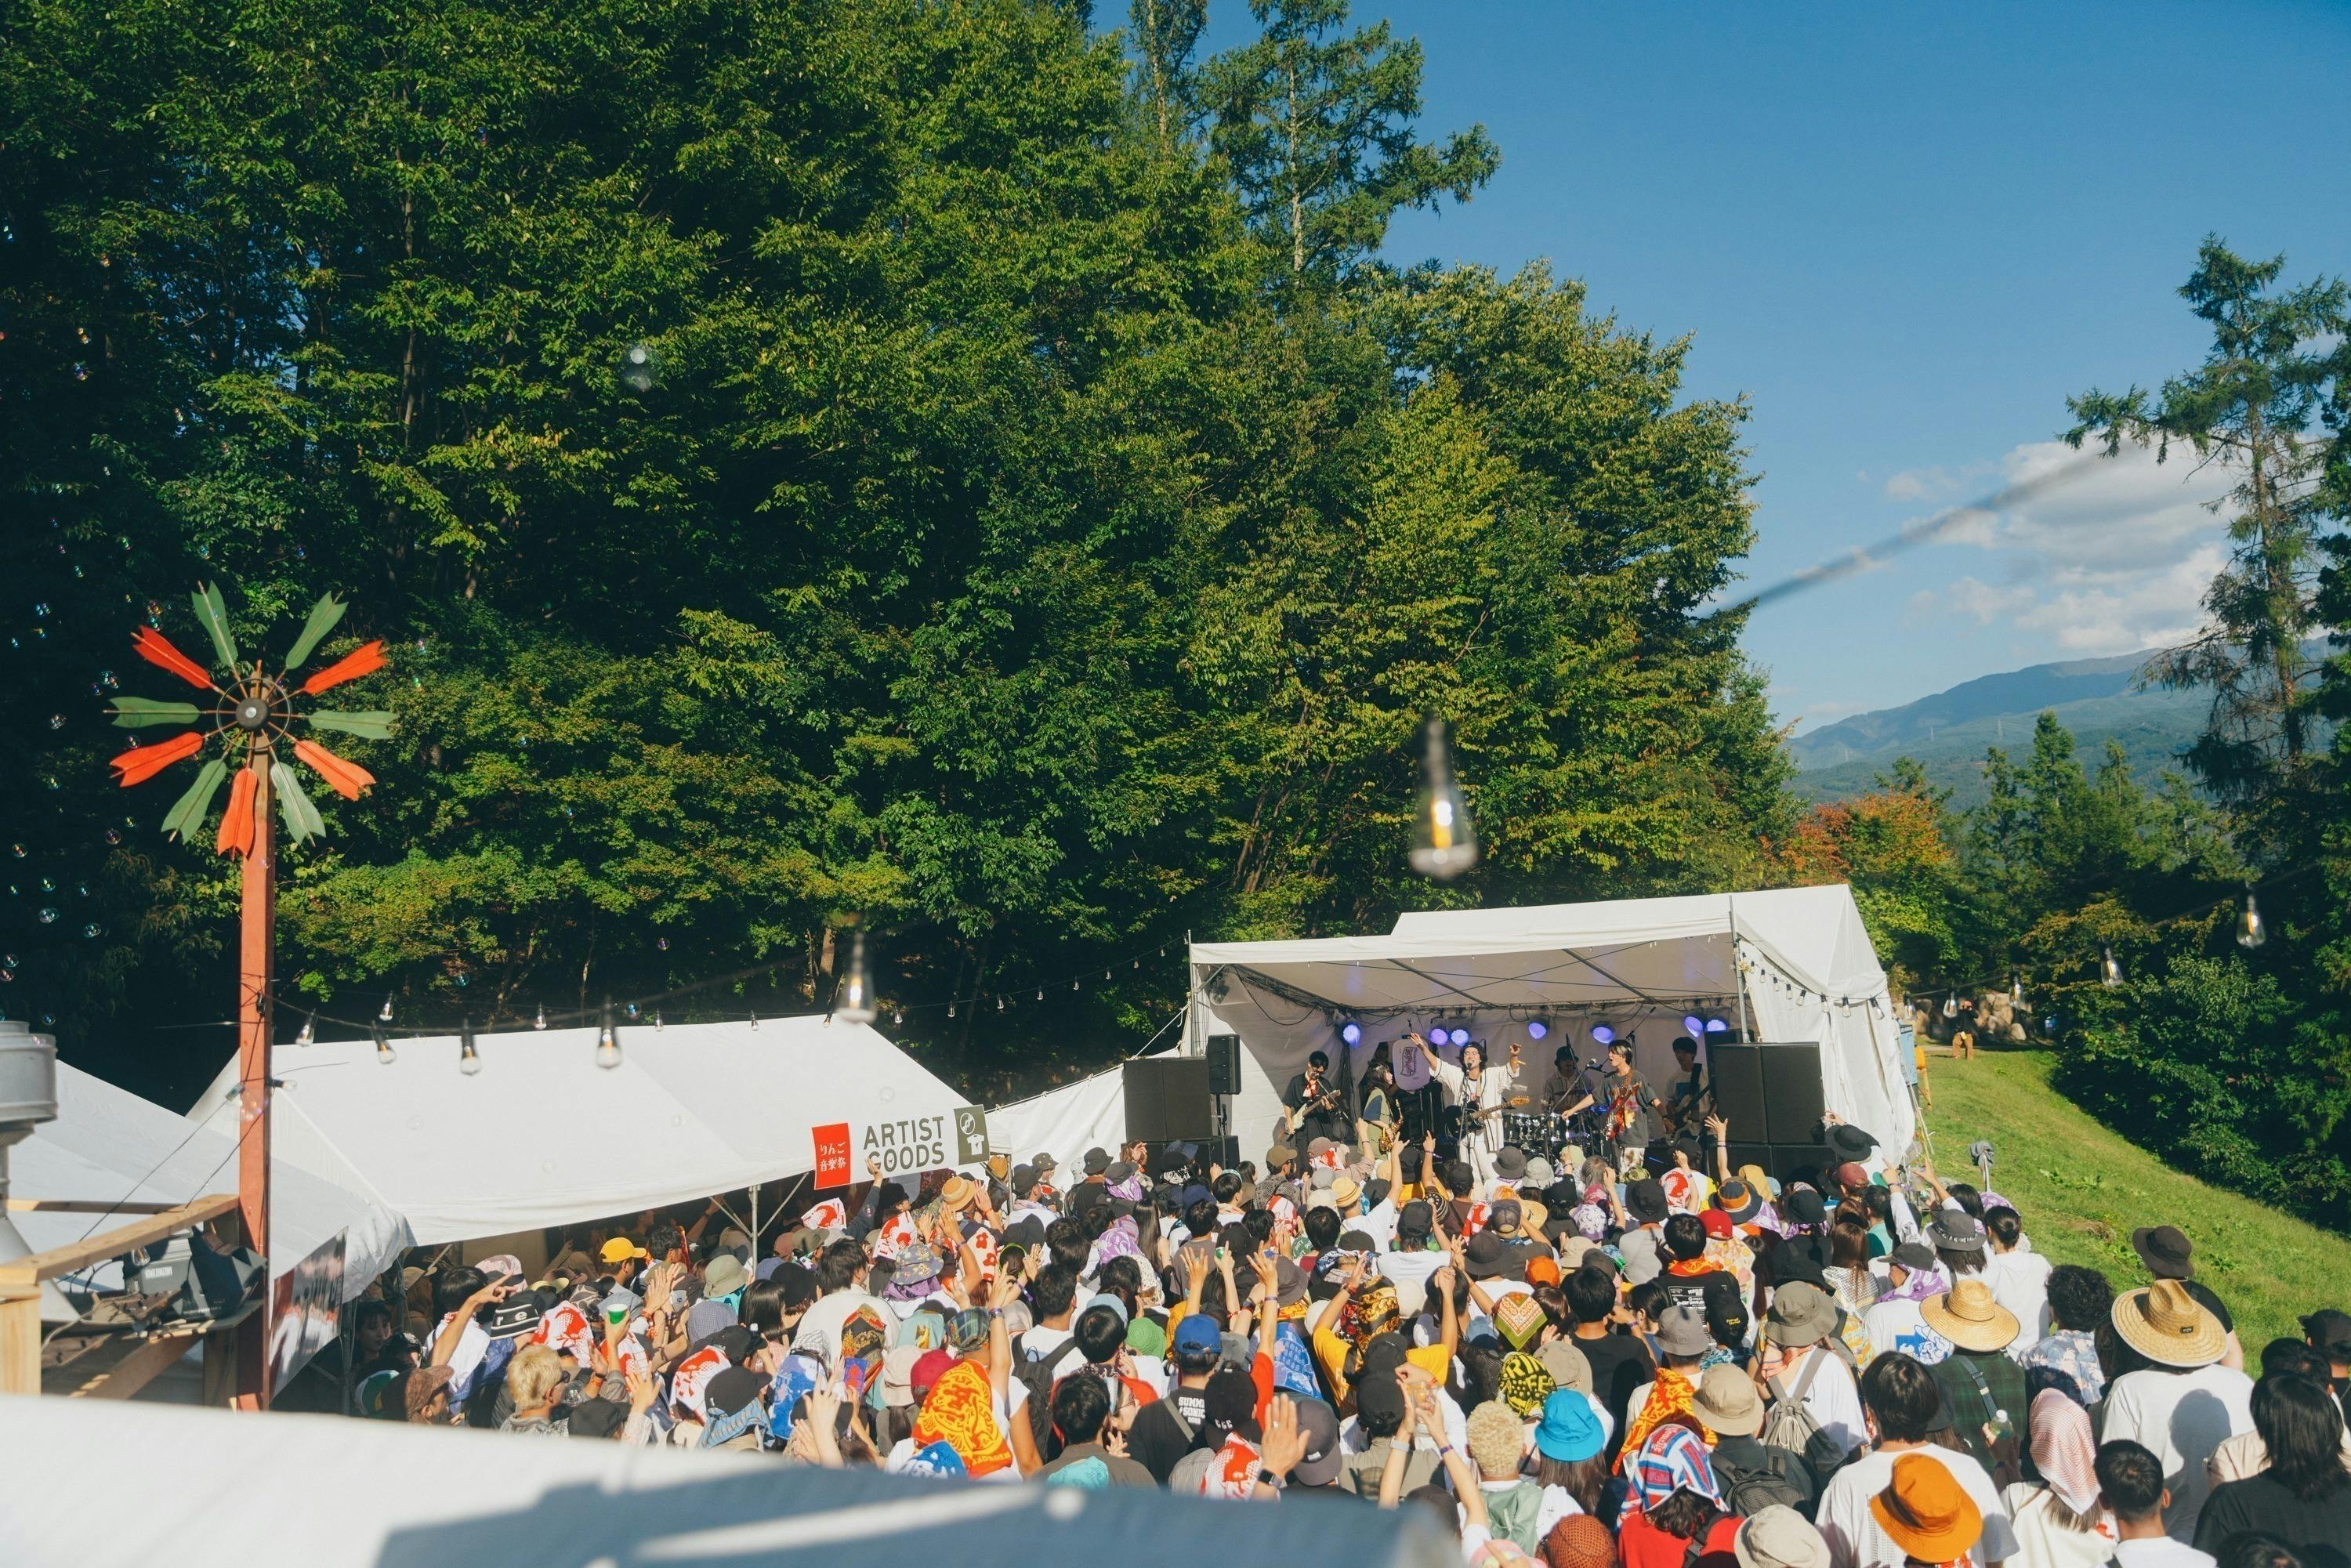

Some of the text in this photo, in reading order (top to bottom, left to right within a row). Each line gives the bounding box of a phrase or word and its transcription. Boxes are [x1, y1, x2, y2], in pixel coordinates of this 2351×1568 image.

[864, 1116, 944, 1150] ARTIST
[820, 1142, 846, 1156] りんご
[867, 1142, 944, 1175] GOODS
[1179, 1396, 1204, 1408] SUMM
[1183, 1407, 1205, 1419] SONIC
